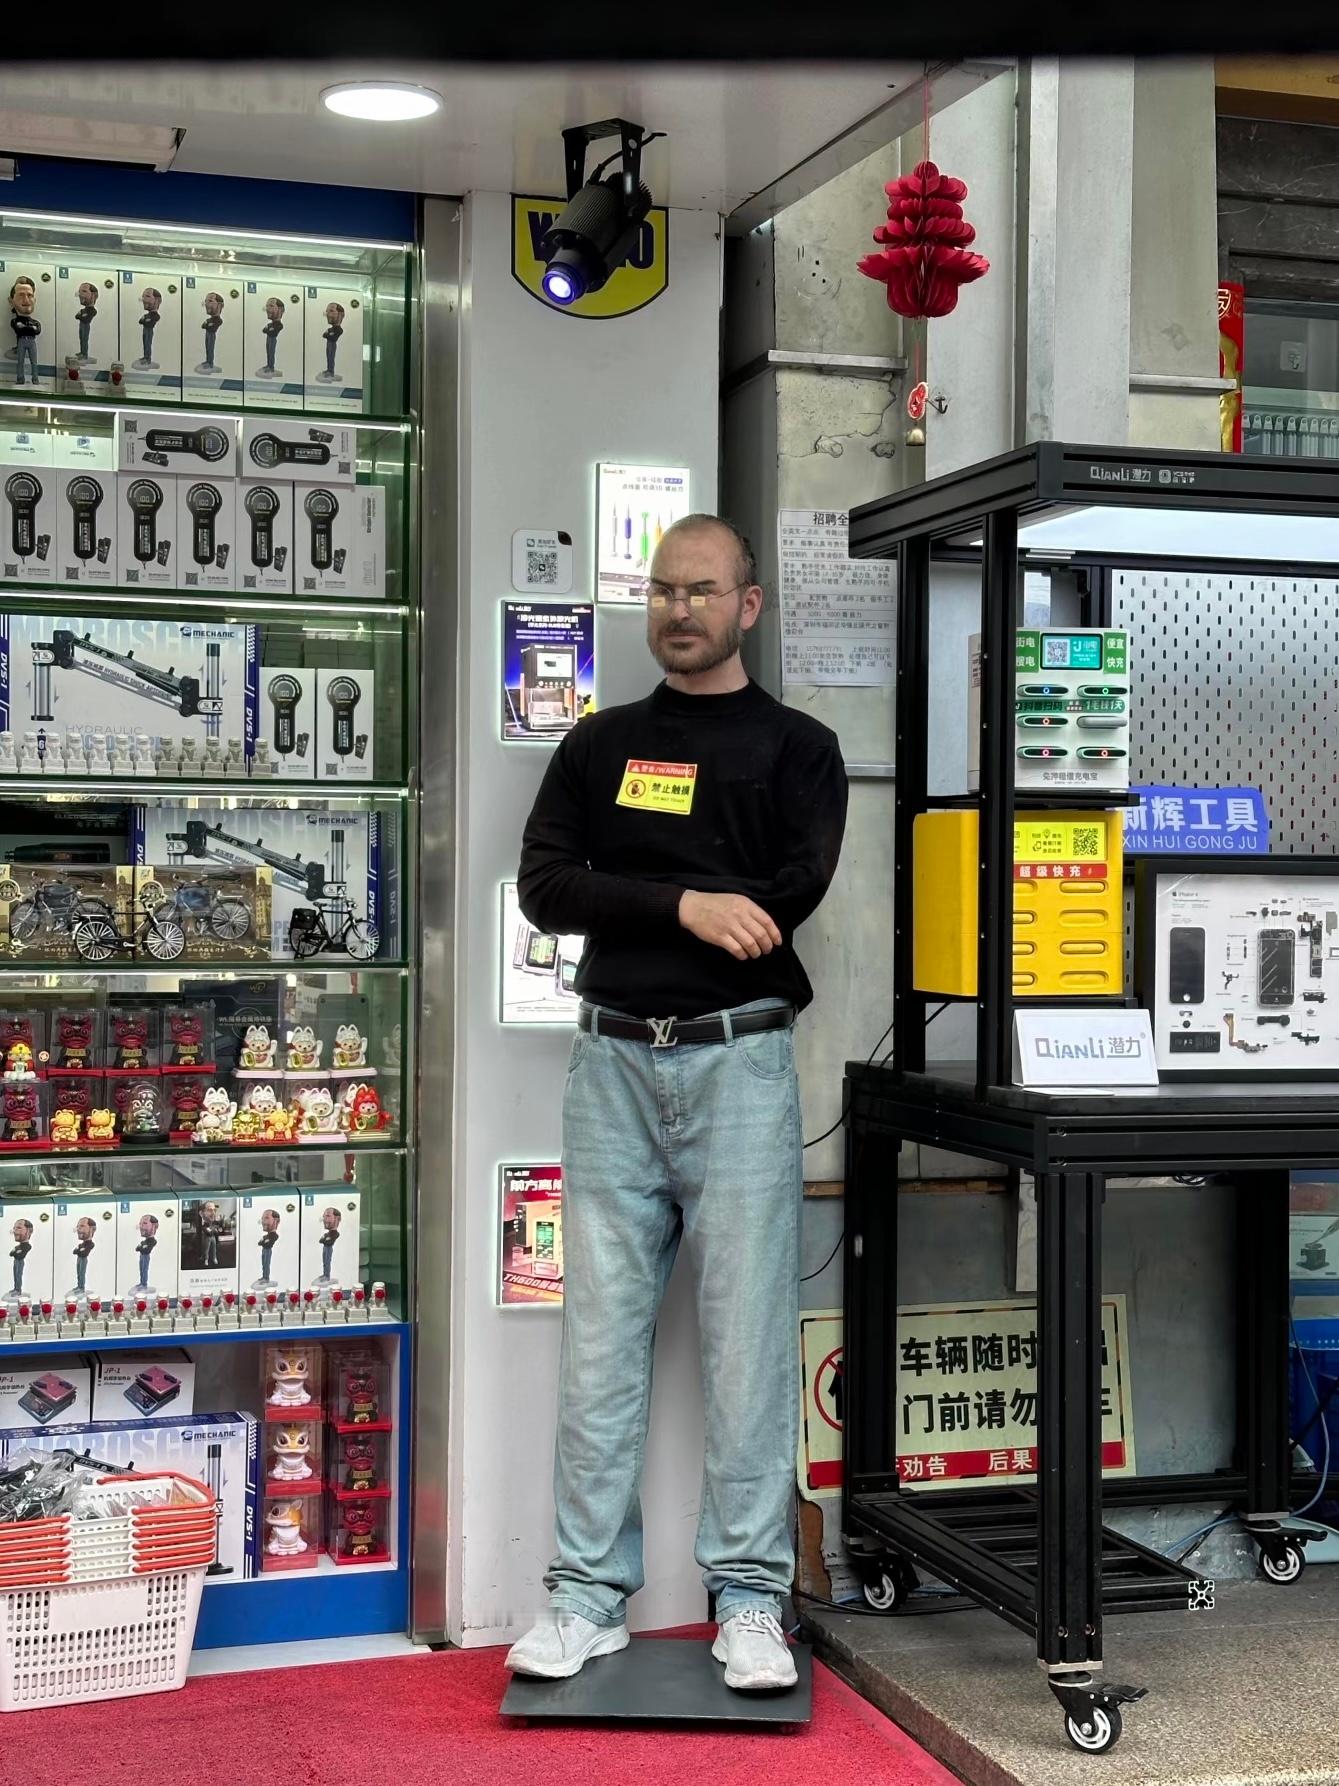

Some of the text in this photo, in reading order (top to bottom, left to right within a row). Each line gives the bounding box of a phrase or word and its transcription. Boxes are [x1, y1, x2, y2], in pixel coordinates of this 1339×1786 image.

[193, 630, 236, 638] MECHANIC
[1106, 637, 1125, 649] 便宜
[1106, 657, 1124, 668] 快充
[651, 782, 691, 796] 禁止触摸
[318, 817, 359, 825] MECHANIC
[1122, 835, 1257, 850] XIN HUI GONG JU
[1020, 865, 1081, 878] 超级快充
[646, 1016, 678, 1048] LV
[193, 1430, 237, 1440] MECHANIC
[245, 1505, 254, 1541] DVS-1
